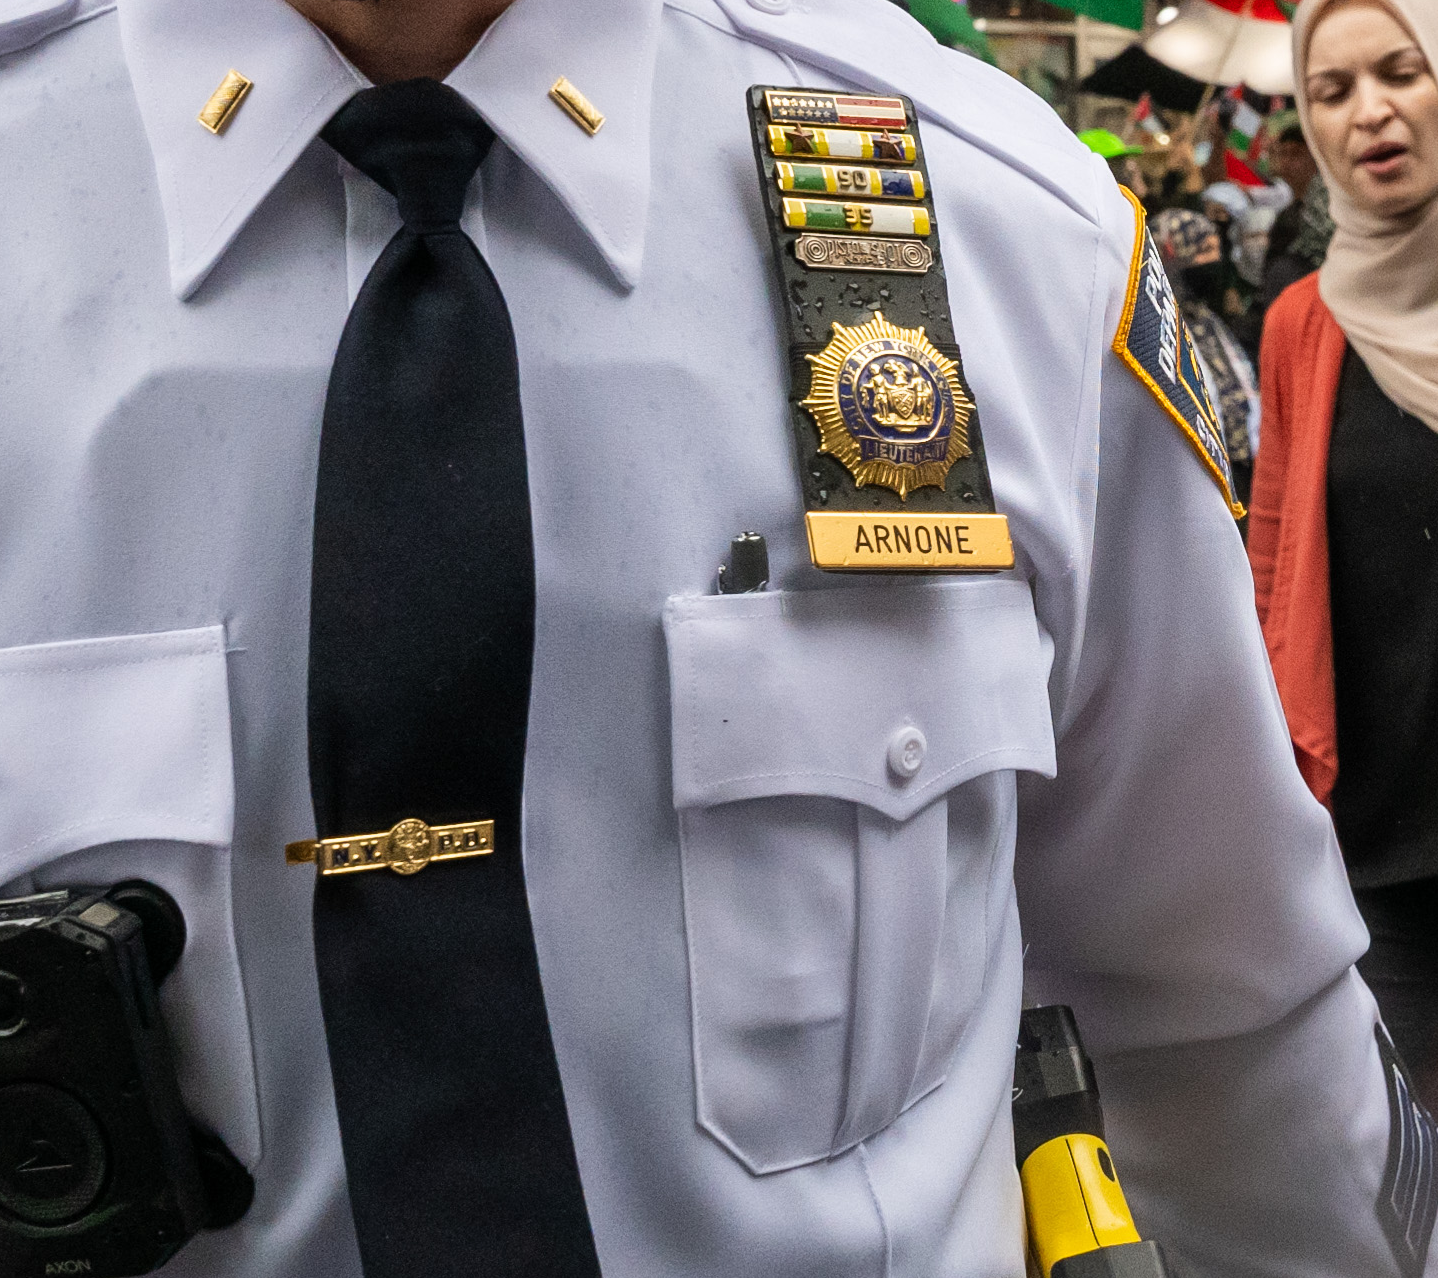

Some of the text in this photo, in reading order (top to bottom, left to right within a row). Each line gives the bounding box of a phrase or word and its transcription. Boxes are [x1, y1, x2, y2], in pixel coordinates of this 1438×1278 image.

[837, 170, 867, 187] 90
[844, 204, 873, 225] 35
[852, 341, 885, 364] NEW
[893, 342, 931, 368] YORK
[865, 441, 946, 462] LIEUTENANT
[855, 525, 974, 555] ARNONE
[46, 1260, 91, 1274] AXON
